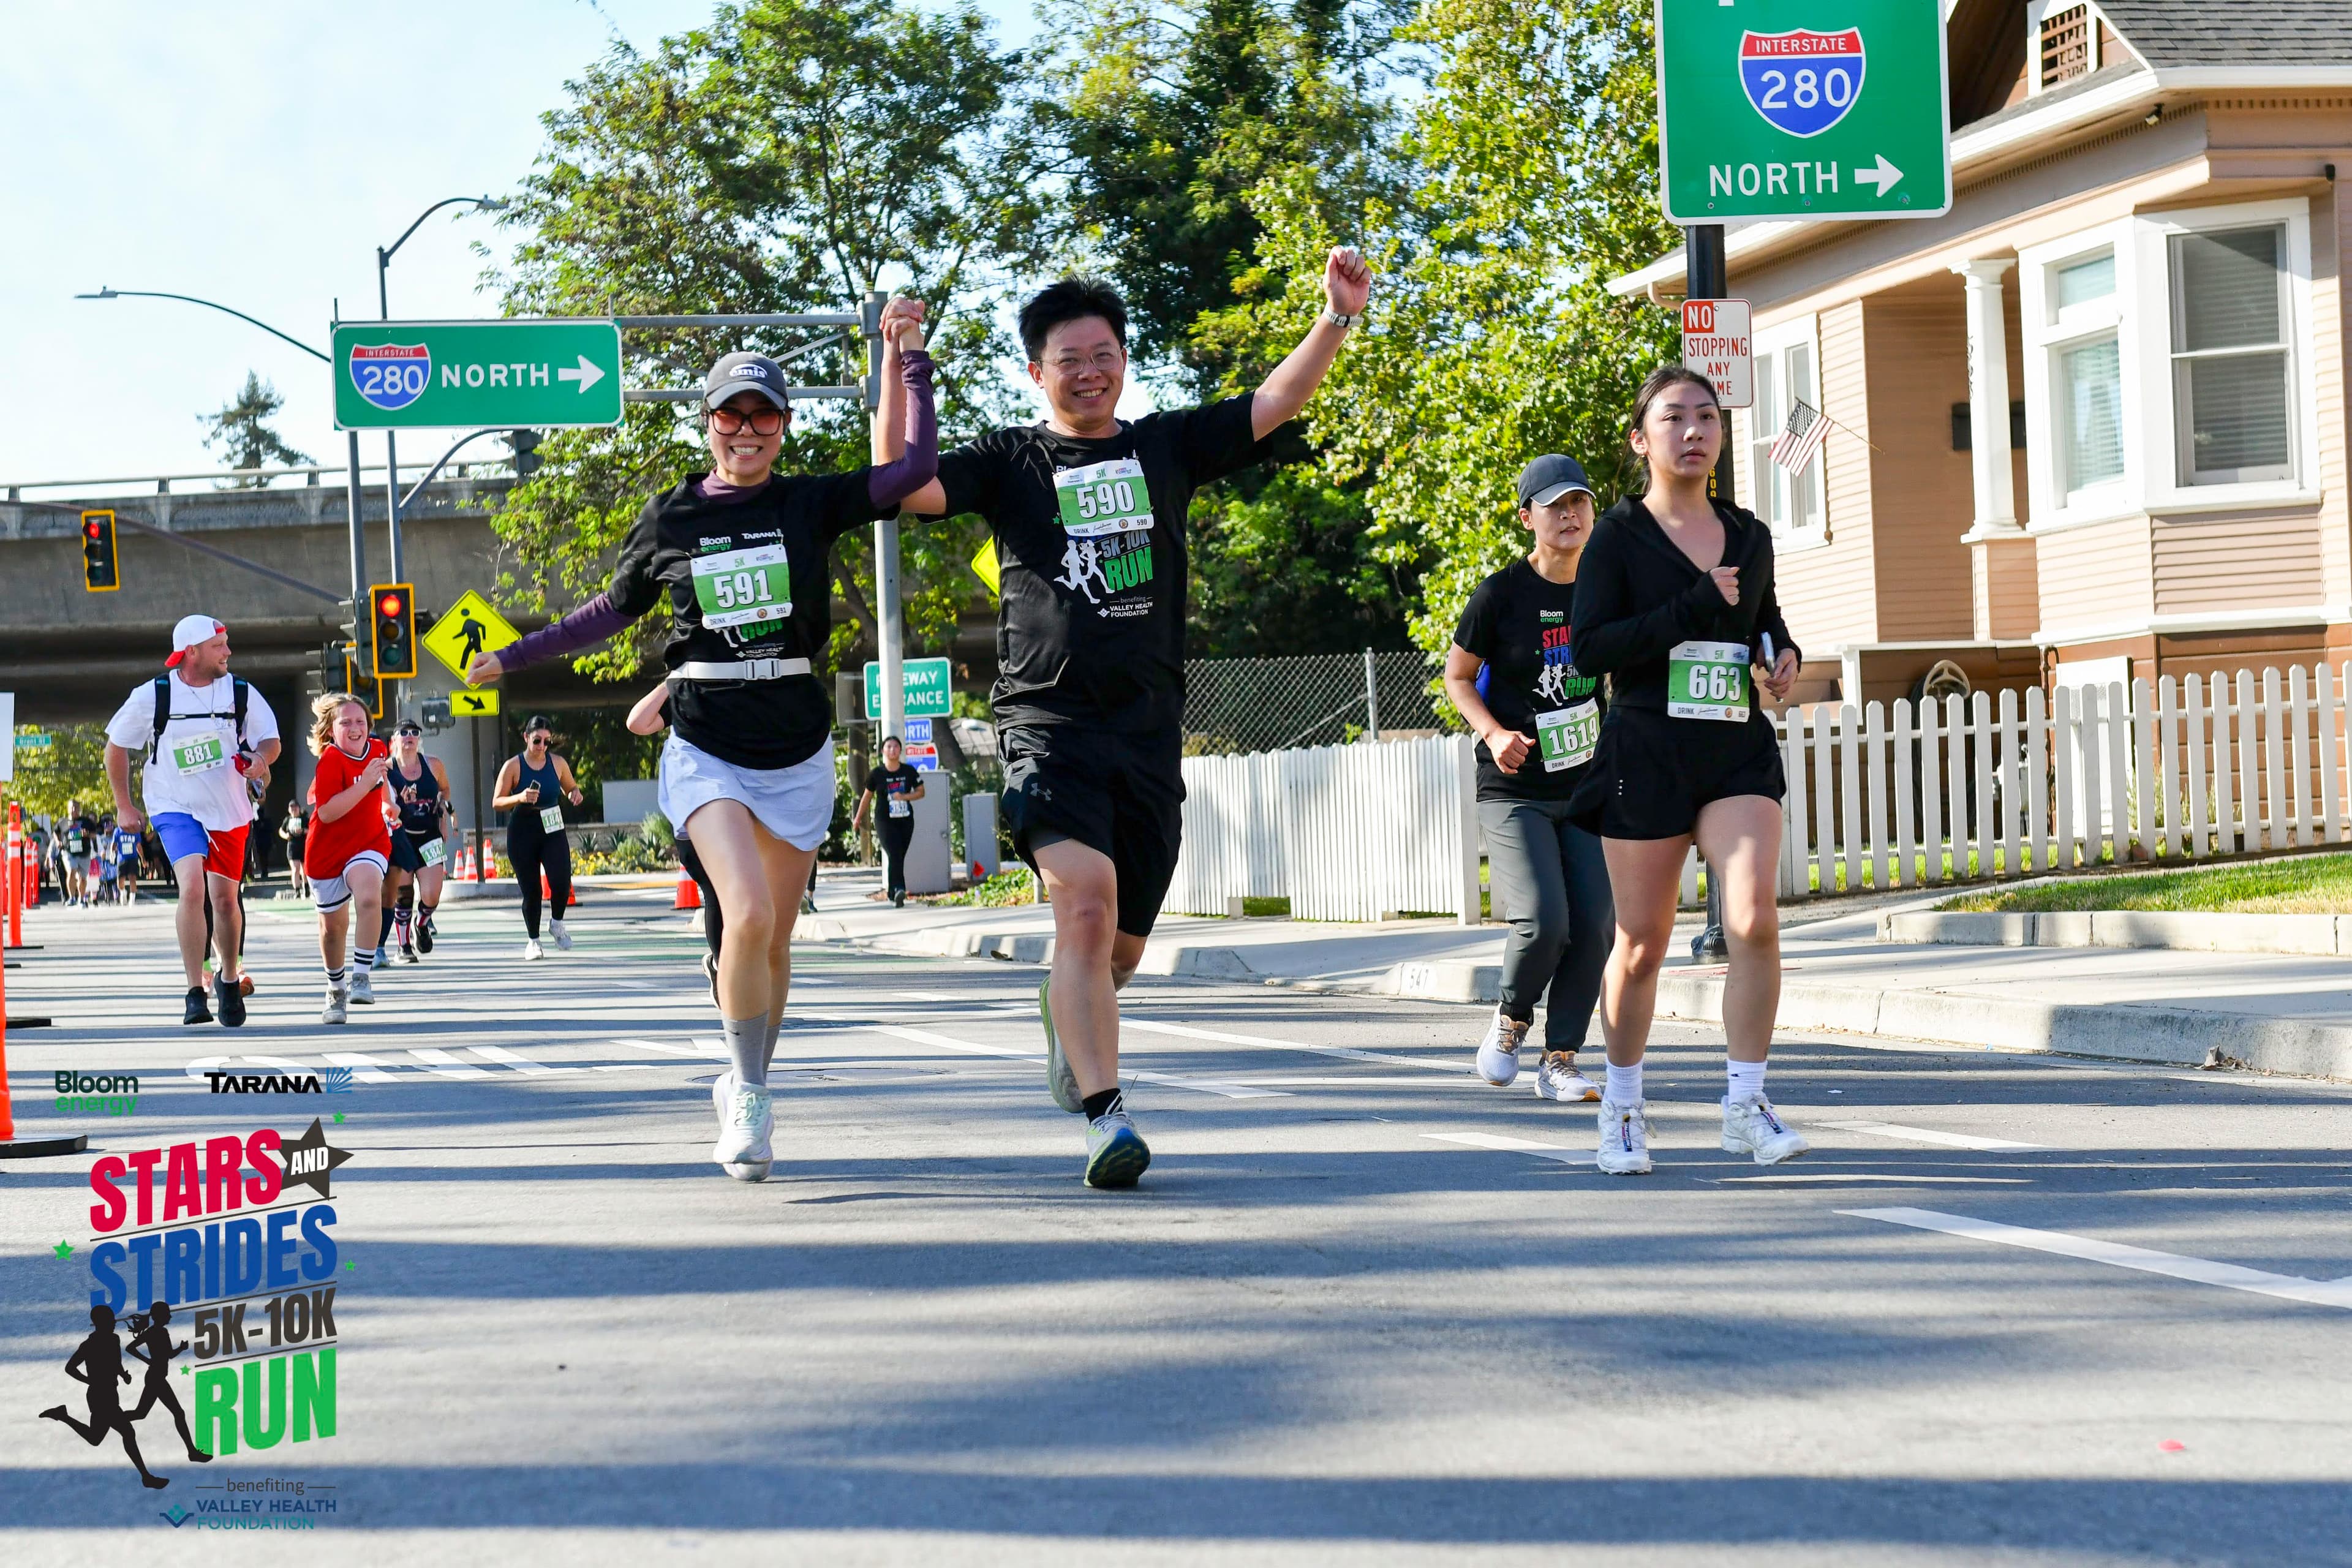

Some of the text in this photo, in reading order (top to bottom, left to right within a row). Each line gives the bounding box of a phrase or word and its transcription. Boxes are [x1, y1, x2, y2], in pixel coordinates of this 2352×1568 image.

[1756, 38, 1846, 53] INTERSTATE
[1760, 68, 1851, 108] 280
[1709, 161, 1838, 197] NORTH
[1688, 306, 1712, 329] NO
[1689, 337, 1747, 357] STOPPING
[363, 365, 424, 395] 280
[441, 363, 549, 388] NORTH
[1707, 362, 1730, 376] ANY
[1096, 469, 1106, 479] 5K
[1076, 481, 1135, 519] 590
[699, 536, 731, 546] Bloom
[700, 543, 731, 552] energy
[1101, 529, 1150, 558] 5K-10K
[1104, 546, 1153, 591] RUN
[713, 569, 773, 608] 591
[1543, 625, 1572, 648] STA
[1689, 665, 1741, 701] 663
[1570, 712, 1578, 721] 5K
[1548, 717, 1598, 755] 1619
[184, 743, 214, 765] 881
